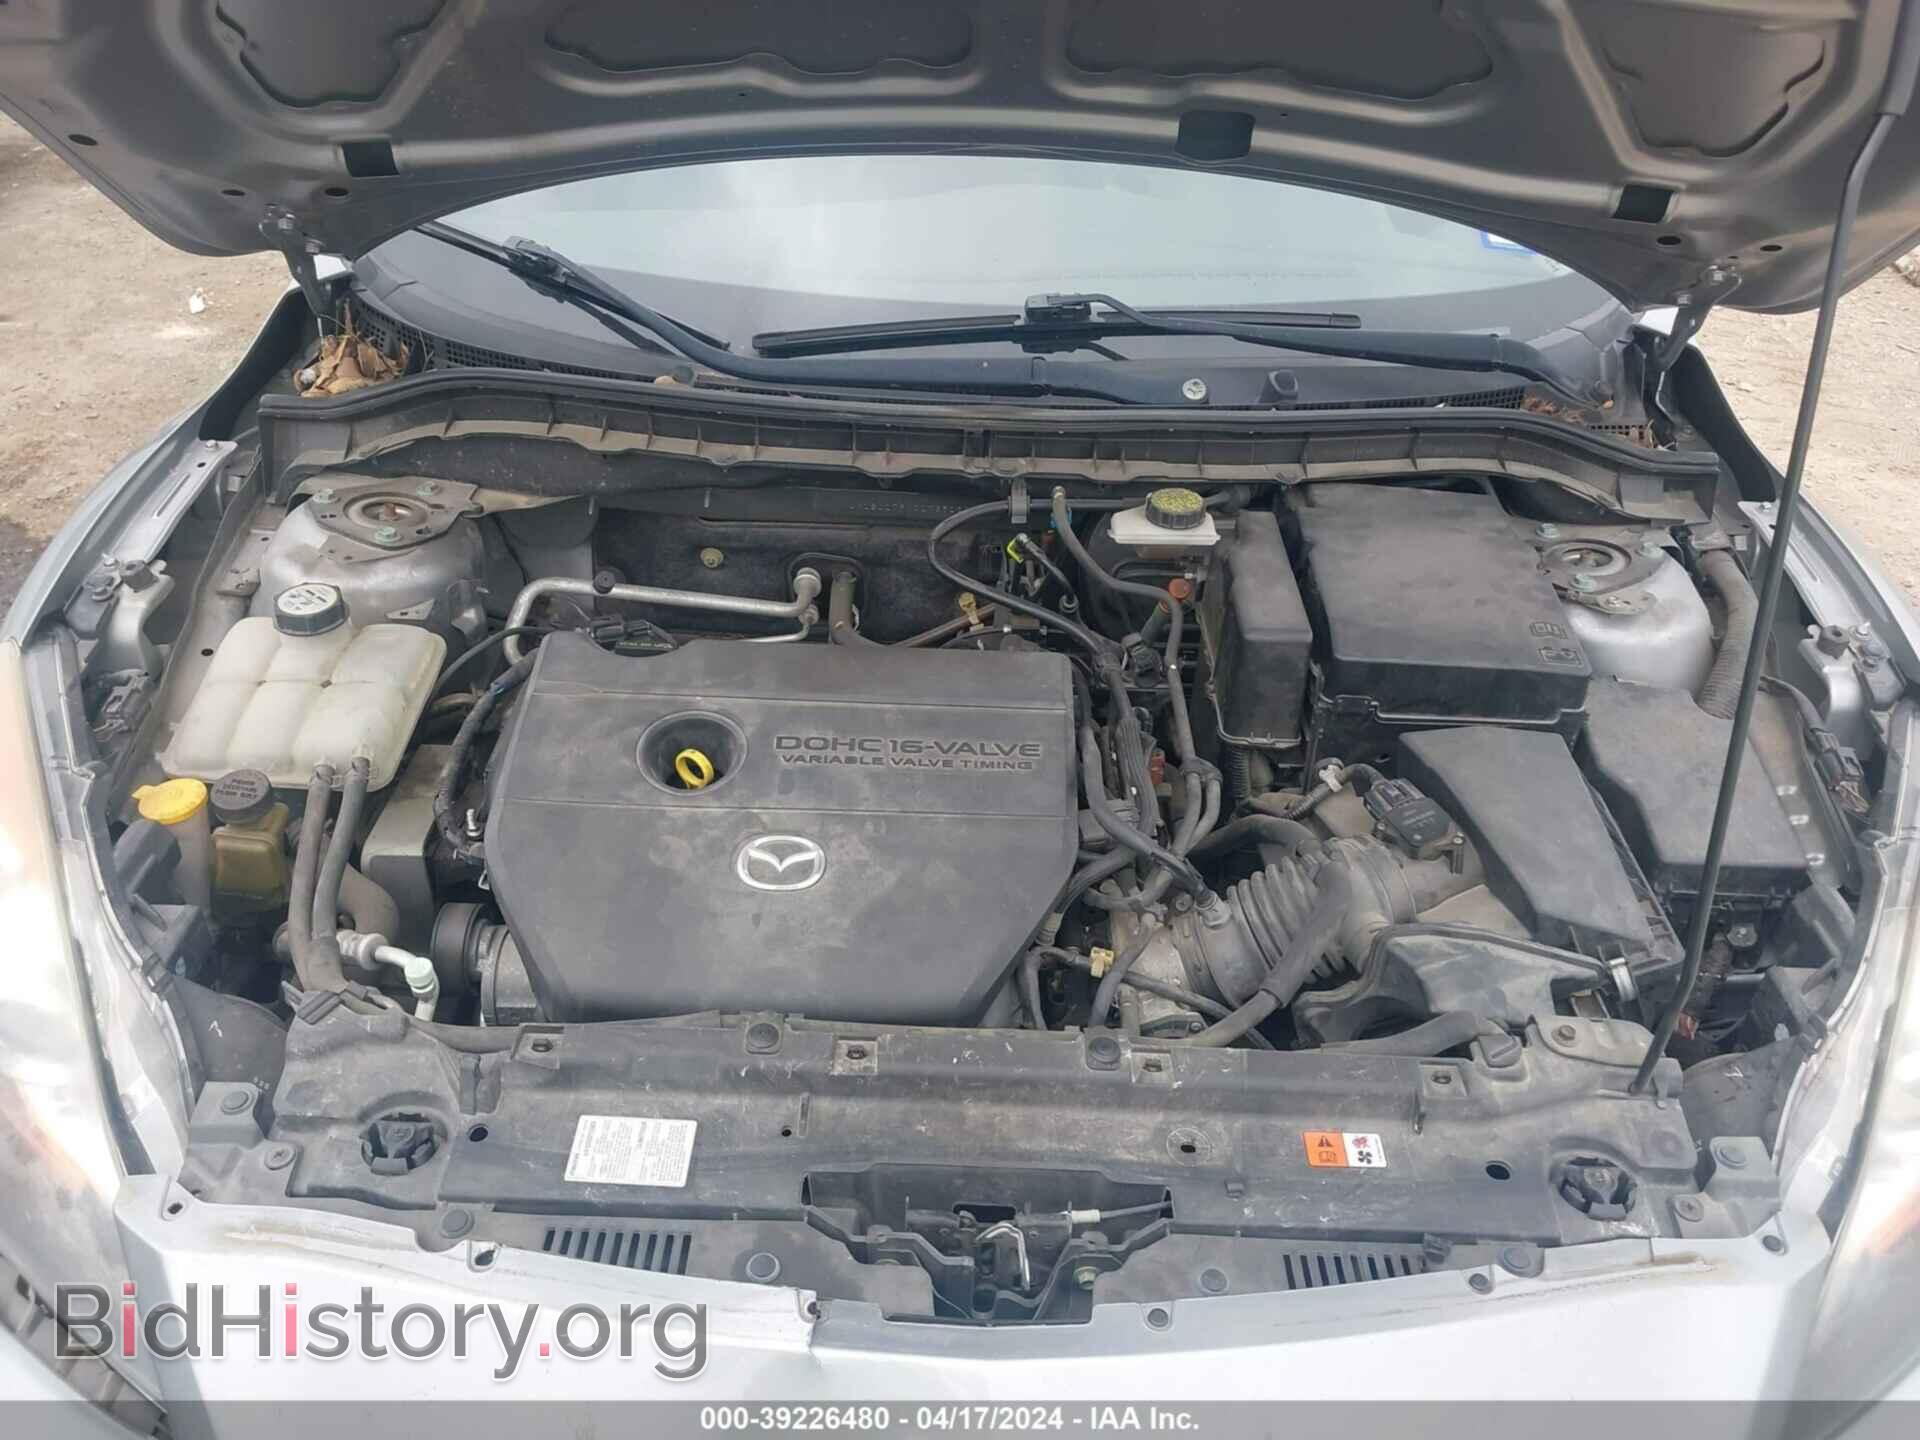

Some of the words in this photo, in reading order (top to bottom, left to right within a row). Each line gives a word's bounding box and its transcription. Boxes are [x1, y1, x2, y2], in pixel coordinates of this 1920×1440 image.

[775, 735, 883, 752] DOHC
[889, 739, 1041, 757] 16-VALVE
[782, 754, 885, 766] VARIABLE
[890, 757, 954, 769] VALVE
[959, 759, 1033, 770] TIMING
